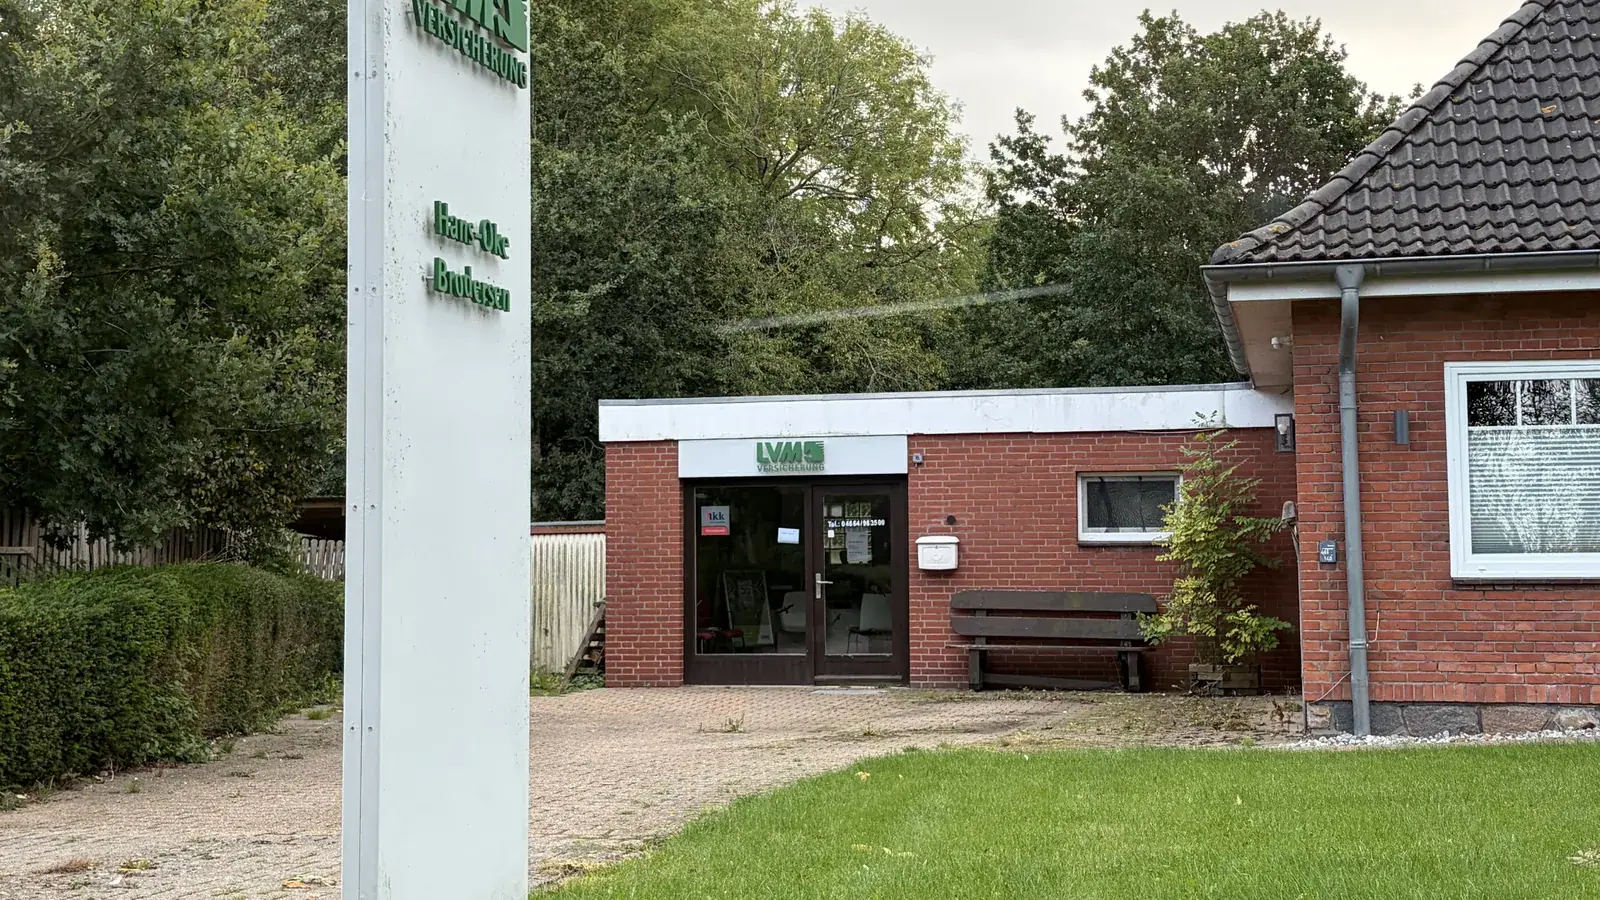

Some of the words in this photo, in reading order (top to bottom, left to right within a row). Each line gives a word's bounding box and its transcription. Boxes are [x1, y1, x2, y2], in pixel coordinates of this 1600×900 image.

[411, 0, 527, 89] VERSICHERUNG
[434, 200, 510, 259] Hans-Oke
[434, 257, 511, 312] Brodersen
[756, 441, 803, 464] LVM
[757, 463, 825, 473] VERSICHERUNG
